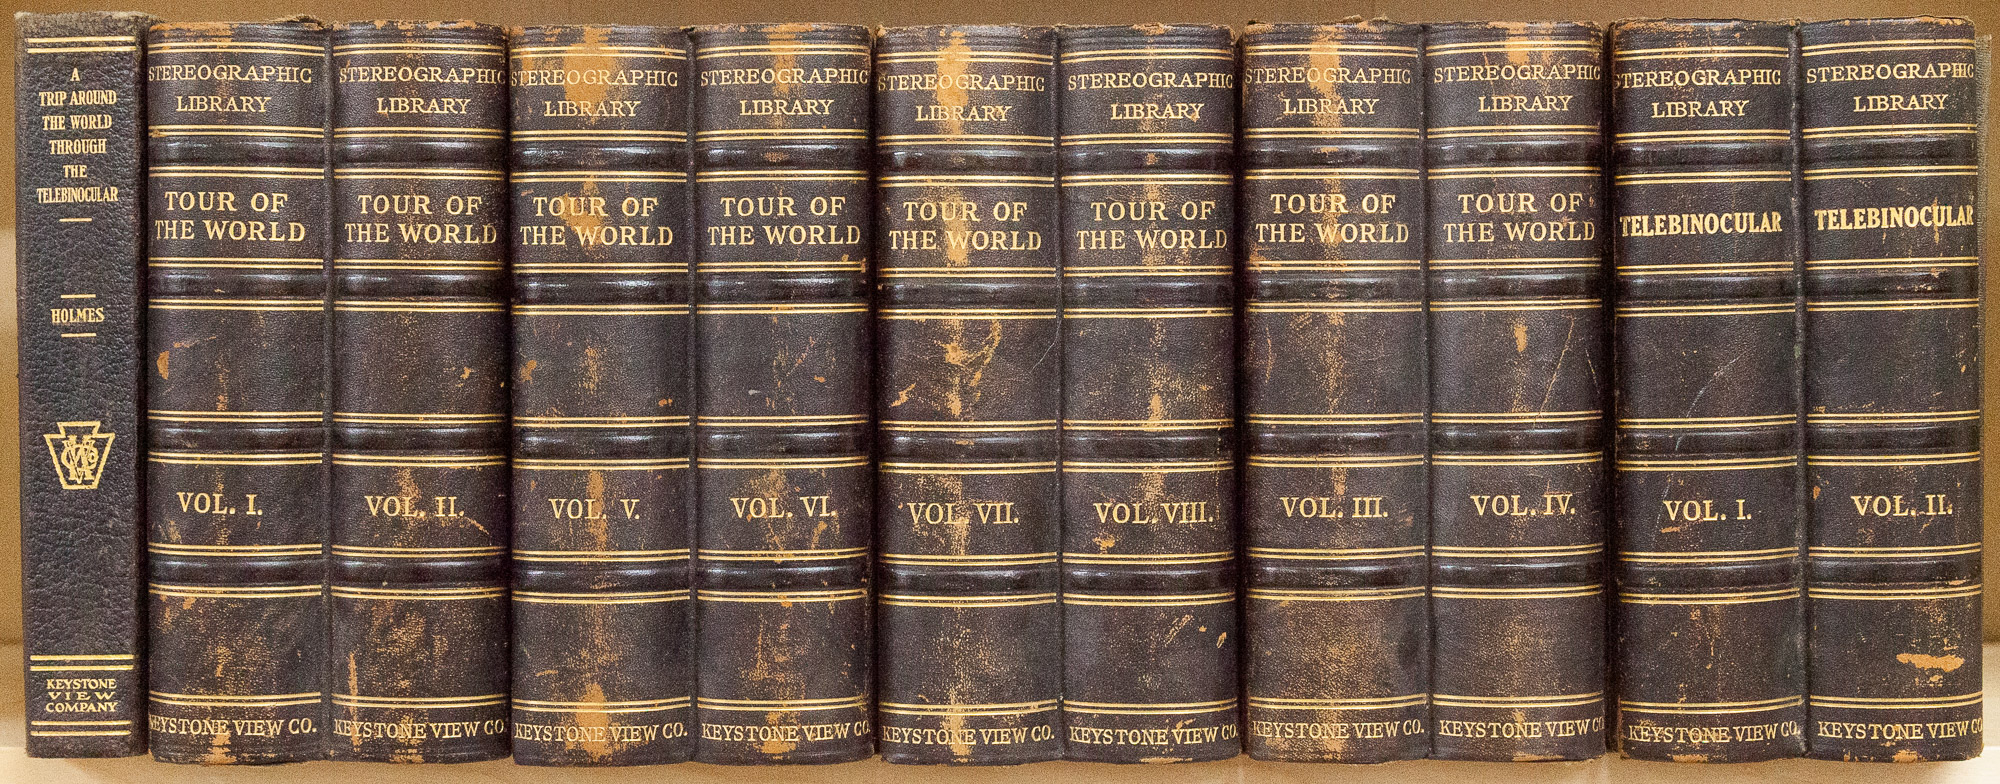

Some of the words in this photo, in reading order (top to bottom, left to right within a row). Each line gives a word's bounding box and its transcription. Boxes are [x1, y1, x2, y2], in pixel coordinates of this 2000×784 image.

[70, 67, 80, 82] A
[149, 65, 312, 83] STEREOGRAPHIC
[340, 66, 506, 84] STEREOGRAPHIC
[511, 70, 678, 86] STEREOGRAPHIC
[701, 68, 868, 86] STEREOGRAPHIC
[878, 74, 1045, 91] STEREOGRAPHIC
[1068, 73, 1233, 90] STEREOGRAPHIC
[1245, 67, 1411, 84] STEREOGRAPHIC
[1434, 65, 1600, 83] STEREOGRAPHIC
[1614, 69, 1781, 89] STEREOGRAPHIC
[1806, 63, 1974, 83] STEREOGRAPHIC
[39, 91, 67, 107] TRIP
[69, 89, 117, 106] AROUND
[176, 96, 271, 112] LIBRARY
[377, 98, 471, 114] LIBRARY
[1283, 99, 1379, 115] LIBRARY
[1478, 96, 1573, 112] LIBRARY
[1853, 94, 1949, 112] LIBRARY
[544, 101, 641, 117] LIBRARY
[739, 100, 834, 116] LIBRARY
[915, 106, 1012, 122] LIBRARY
[1111, 103, 1204, 120] LIBRARY
[1652, 100, 1749, 118] LIBRARY
[42, 115, 65, 131] THE
[70, 114, 112, 130] WORLD
[49, 138, 107, 155] THROUGH
[63, 164, 88, 178] THE
[37, 186, 119, 204] TELEBINOCULAR
[165, 192, 237, 211] TOUR
[251, 193, 288, 212] OF
[1270, 194, 1349, 214] TOUR
[1362, 194, 1395, 214] OF
[1458, 193, 1537, 214] TOUR
[1550, 193, 1583, 212] OF
[358, 195, 432, 214] TOUR
[446, 196, 482, 215] OF
[533, 197, 608, 216] TOUR
[622, 197, 658, 217] OF
[720, 197, 797, 216] TOUR
[810, 196, 845, 215] OF
[903, 202, 980, 221] TOUR
[993, 202, 1027, 221] OF
[1091, 202, 1168, 221] TOUR
[1182, 201, 1215, 220] OF
[1620, 211, 1782, 237] TELEBINOCULAR
[1815, 205, 1974, 230] TELEBINOCULAR
[155, 220, 194, 240] THE
[203, 220, 305, 241] WORLD
[345, 223, 389, 242] THE
[398, 224, 497, 244] WORLD
[520, 226, 566, 245] THE
[574, 226, 673, 246] WORLD
[708, 226, 755, 246] THE
[762, 225, 860, 245] WORLD
[889, 230, 937, 250] THE
[945, 230, 1041, 250] WORLD
[1077, 230, 1125, 250] THE
[1134, 229, 1227, 249] WORLD
[1256, 224, 1305, 243] THE
[1314, 223, 1409, 243] WORLD
[1443, 223, 1494, 242] THE
[1503, 221, 1595, 242] WORLD
[51, 307, 105, 324] HOLMES
[176, 492, 236, 515] VOL.
[246, 494, 263, 516] I.
[364, 496, 425, 518] VOL.
[435, 496, 464, 517] II.
[548, 498, 607, 519] VOL.
[620, 499, 640, 519] V.
[730, 497, 793, 518] VOL.
[800, 496, 836, 517] VI.
[973, 502, 1019, 524] VII.
[1161, 501, 1214, 523] VIII.
[1280, 497, 1343, 518] VOL.
[1351, 497, 1388, 518] III.
[1471, 495, 1536, 516] VOL.
[1543, 494, 1575, 516] IV.
[1663, 500, 1726, 521] VOL.
[1736, 499, 1752, 520] I.
[1851, 495, 1916, 517] VOL.
[46, 678, 117, 690] KEYSTONE
[45, 701, 119, 713] COMPANY
[232, 719, 284, 736] VIEW
[288, 718, 317, 734] CO.
[333, 719, 427, 738] KEYSTONE
[430, 721, 480, 738] VIEW
[514, 723, 605, 742] KEYSTONE
[609, 725, 659, 742] VIEW
[662, 722, 688, 739] CO.
[702, 723, 800, 742] KEYSTONE
[802, 723, 850, 741] VIEW
[882, 726, 977, 745] KEYSTONE
[979, 728, 1028, 745] VIEW
[1031, 725, 1055, 742] CO.
[1070, 726, 1168, 745] KEYSTONE
[1171, 727, 1218, 745] VIEW
[1253, 721, 1349, 738] KEYSTONE
[1352, 721, 1400, 738] VIEW
[1403, 719, 1424, 735] CO.
[1439, 720, 1542, 738] KEYSTONE
[1545, 719, 1590, 737] VIEW
[1628, 725, 1730, 743] KEYSTONE
[1733, 723, 1778, 742] VIEW
[1818, 721, 1923, 739] KEYSTONE
[1926, 720, 1969, 739] VIEW
